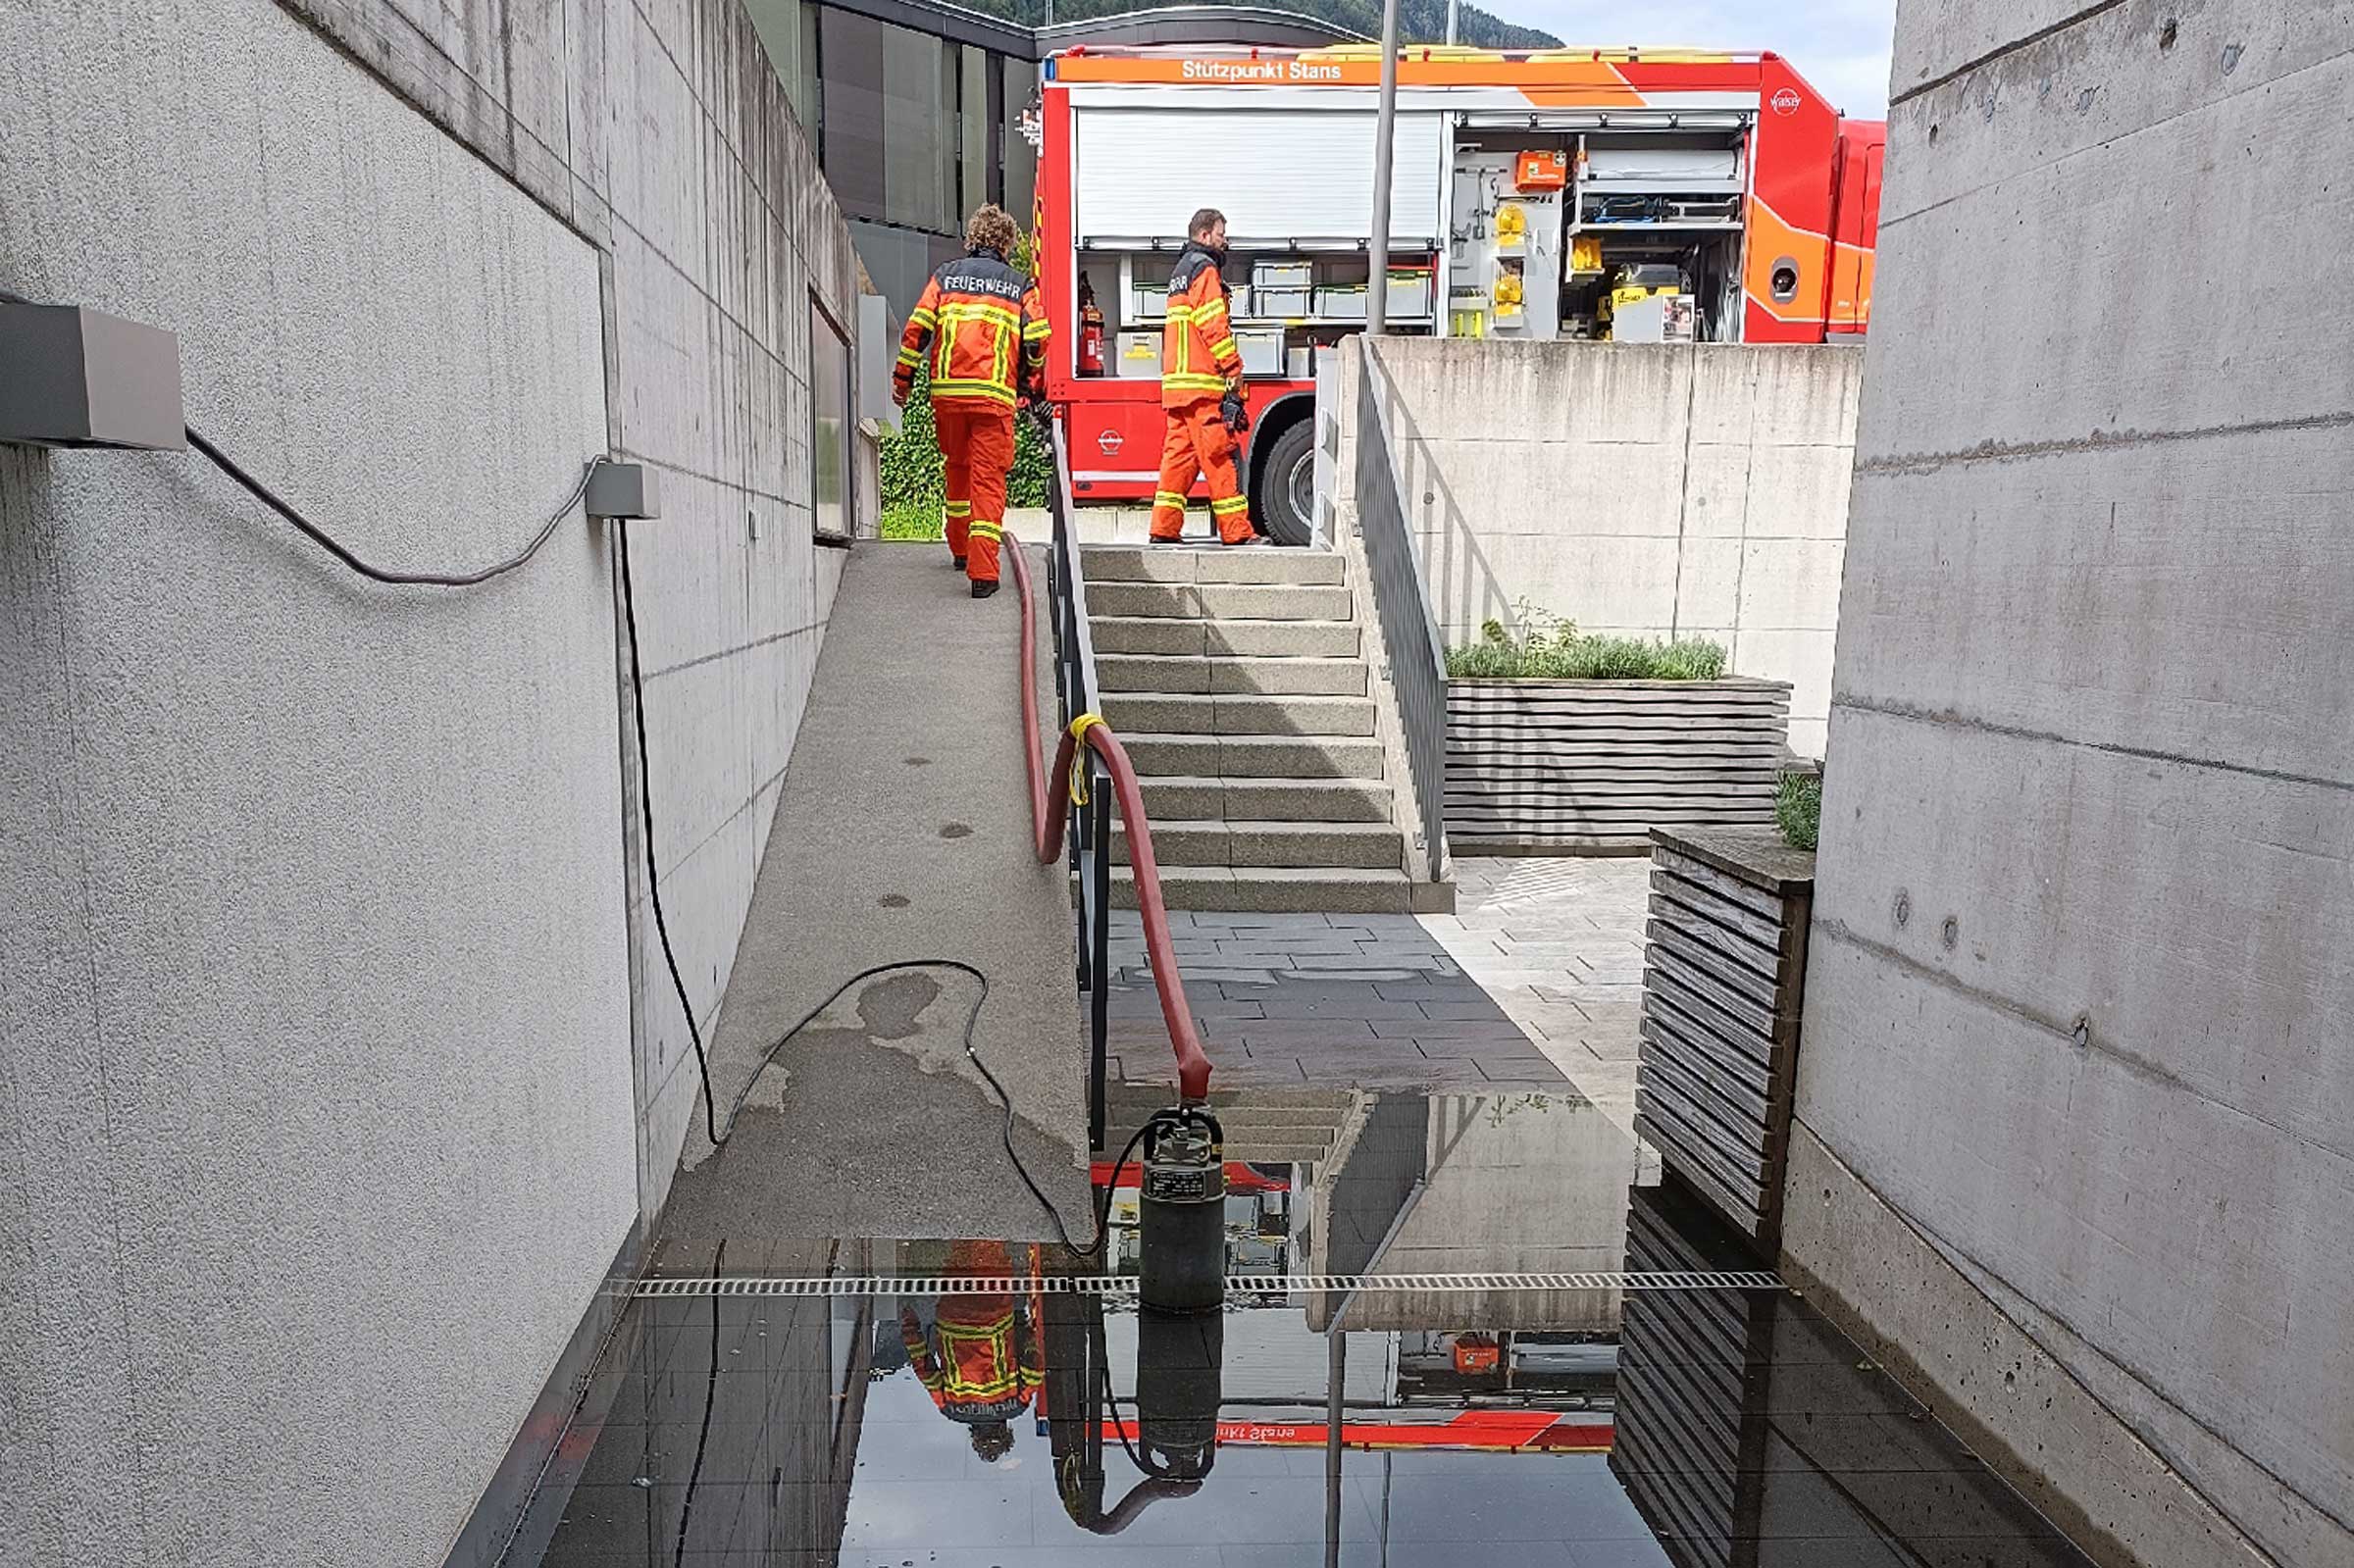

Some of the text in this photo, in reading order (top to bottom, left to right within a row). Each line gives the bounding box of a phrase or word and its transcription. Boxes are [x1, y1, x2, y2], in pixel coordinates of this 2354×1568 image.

[1182, 61, 1342, 81] Stützpunkt Stans
[944, 276, 1020, 299] FEUERWEHR
